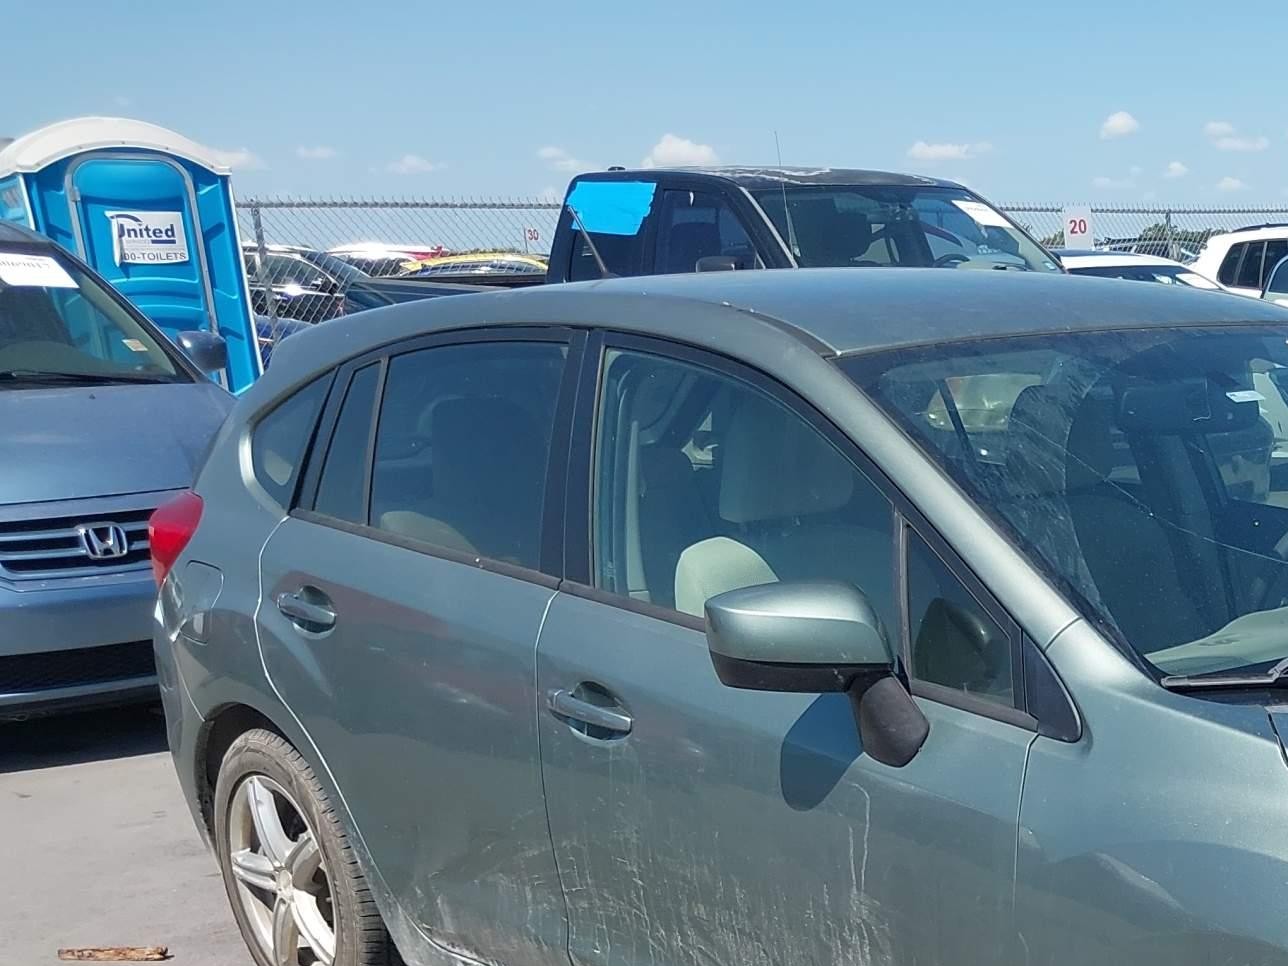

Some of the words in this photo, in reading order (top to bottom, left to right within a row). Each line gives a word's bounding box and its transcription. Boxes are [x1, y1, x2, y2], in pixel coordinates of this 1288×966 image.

[1069, 219, 1087, 234] 20
[527, 229, 539, 241] 30
[119, 252, 186, 261] 00-TOILETS
